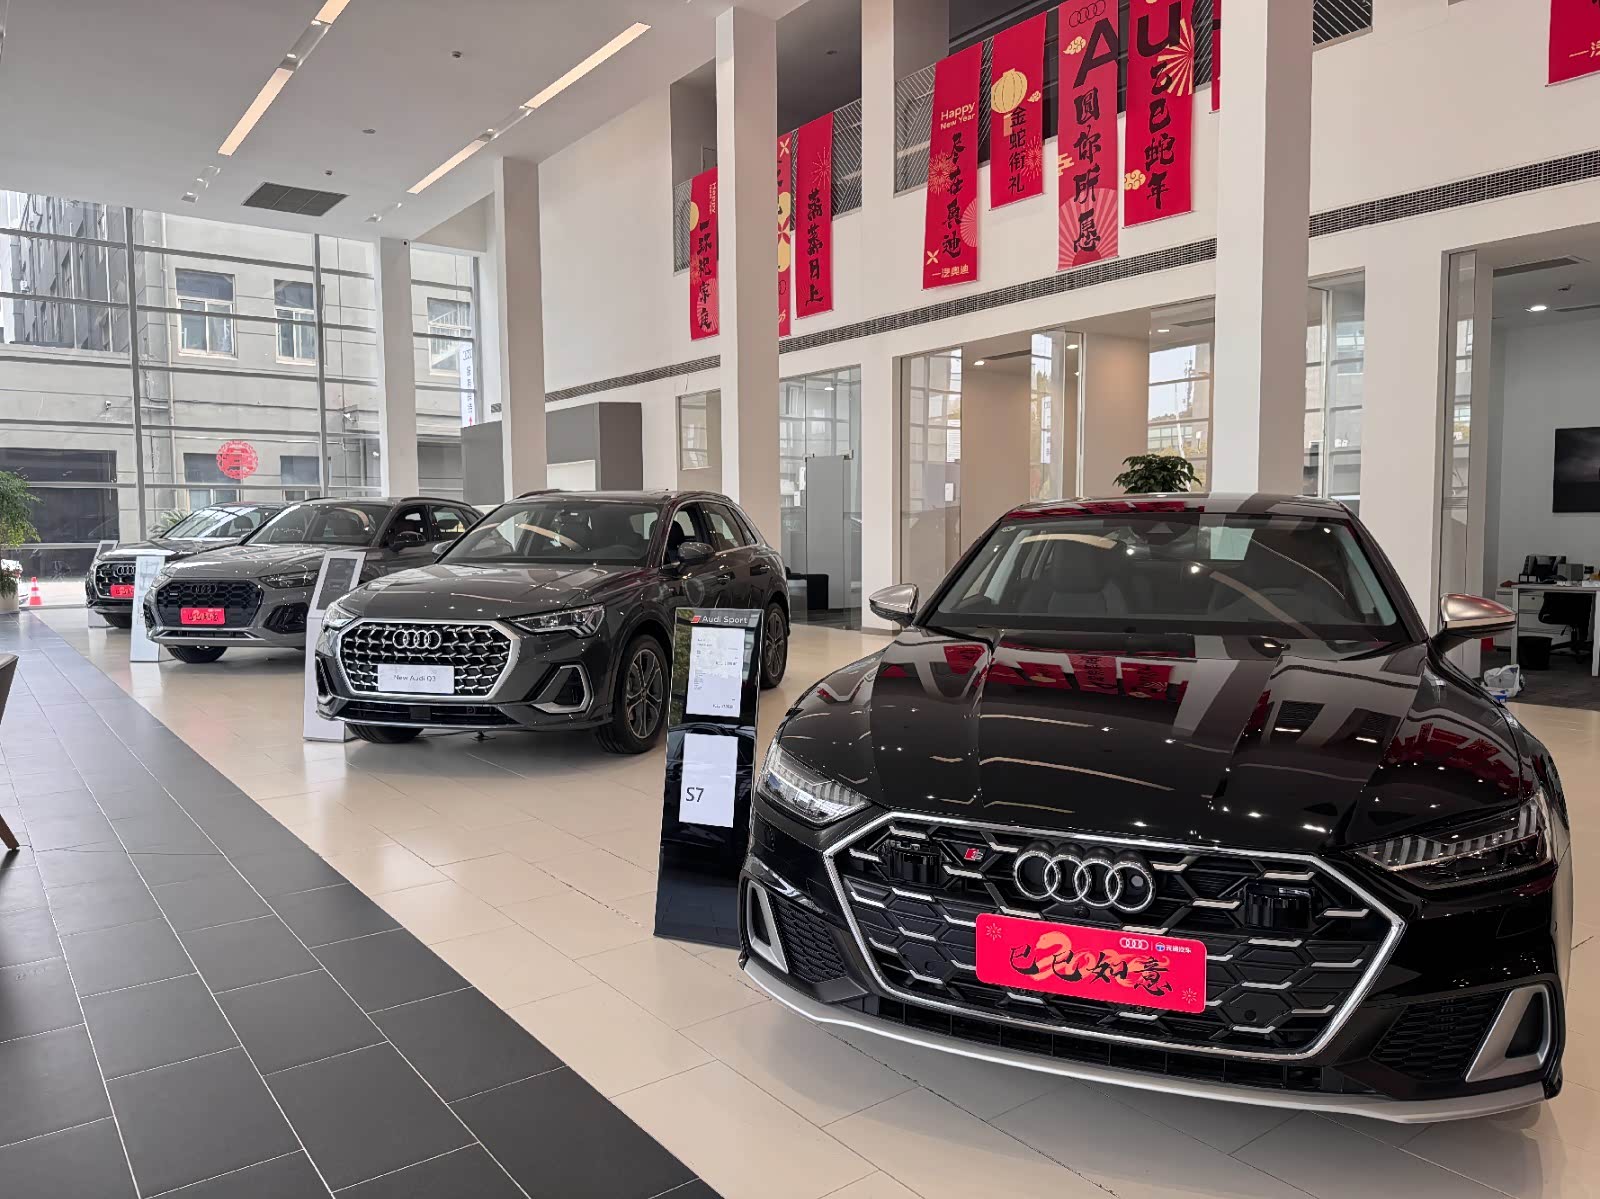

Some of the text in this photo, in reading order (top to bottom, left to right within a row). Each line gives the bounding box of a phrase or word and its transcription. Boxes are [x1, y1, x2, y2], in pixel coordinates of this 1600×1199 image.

[940, 102, 976, 121] Happy
[940, 112, 976, 130] New Year
[1008, 106, 1027, 194] 金蛇衔礼
[805, 188, 824, 306] 蒸蒸日上
[931, 263, 970, 279] 一汽奥迪
[701, 615, 748, 625] Audi Sport
[685, 786, 704, 802] S7
